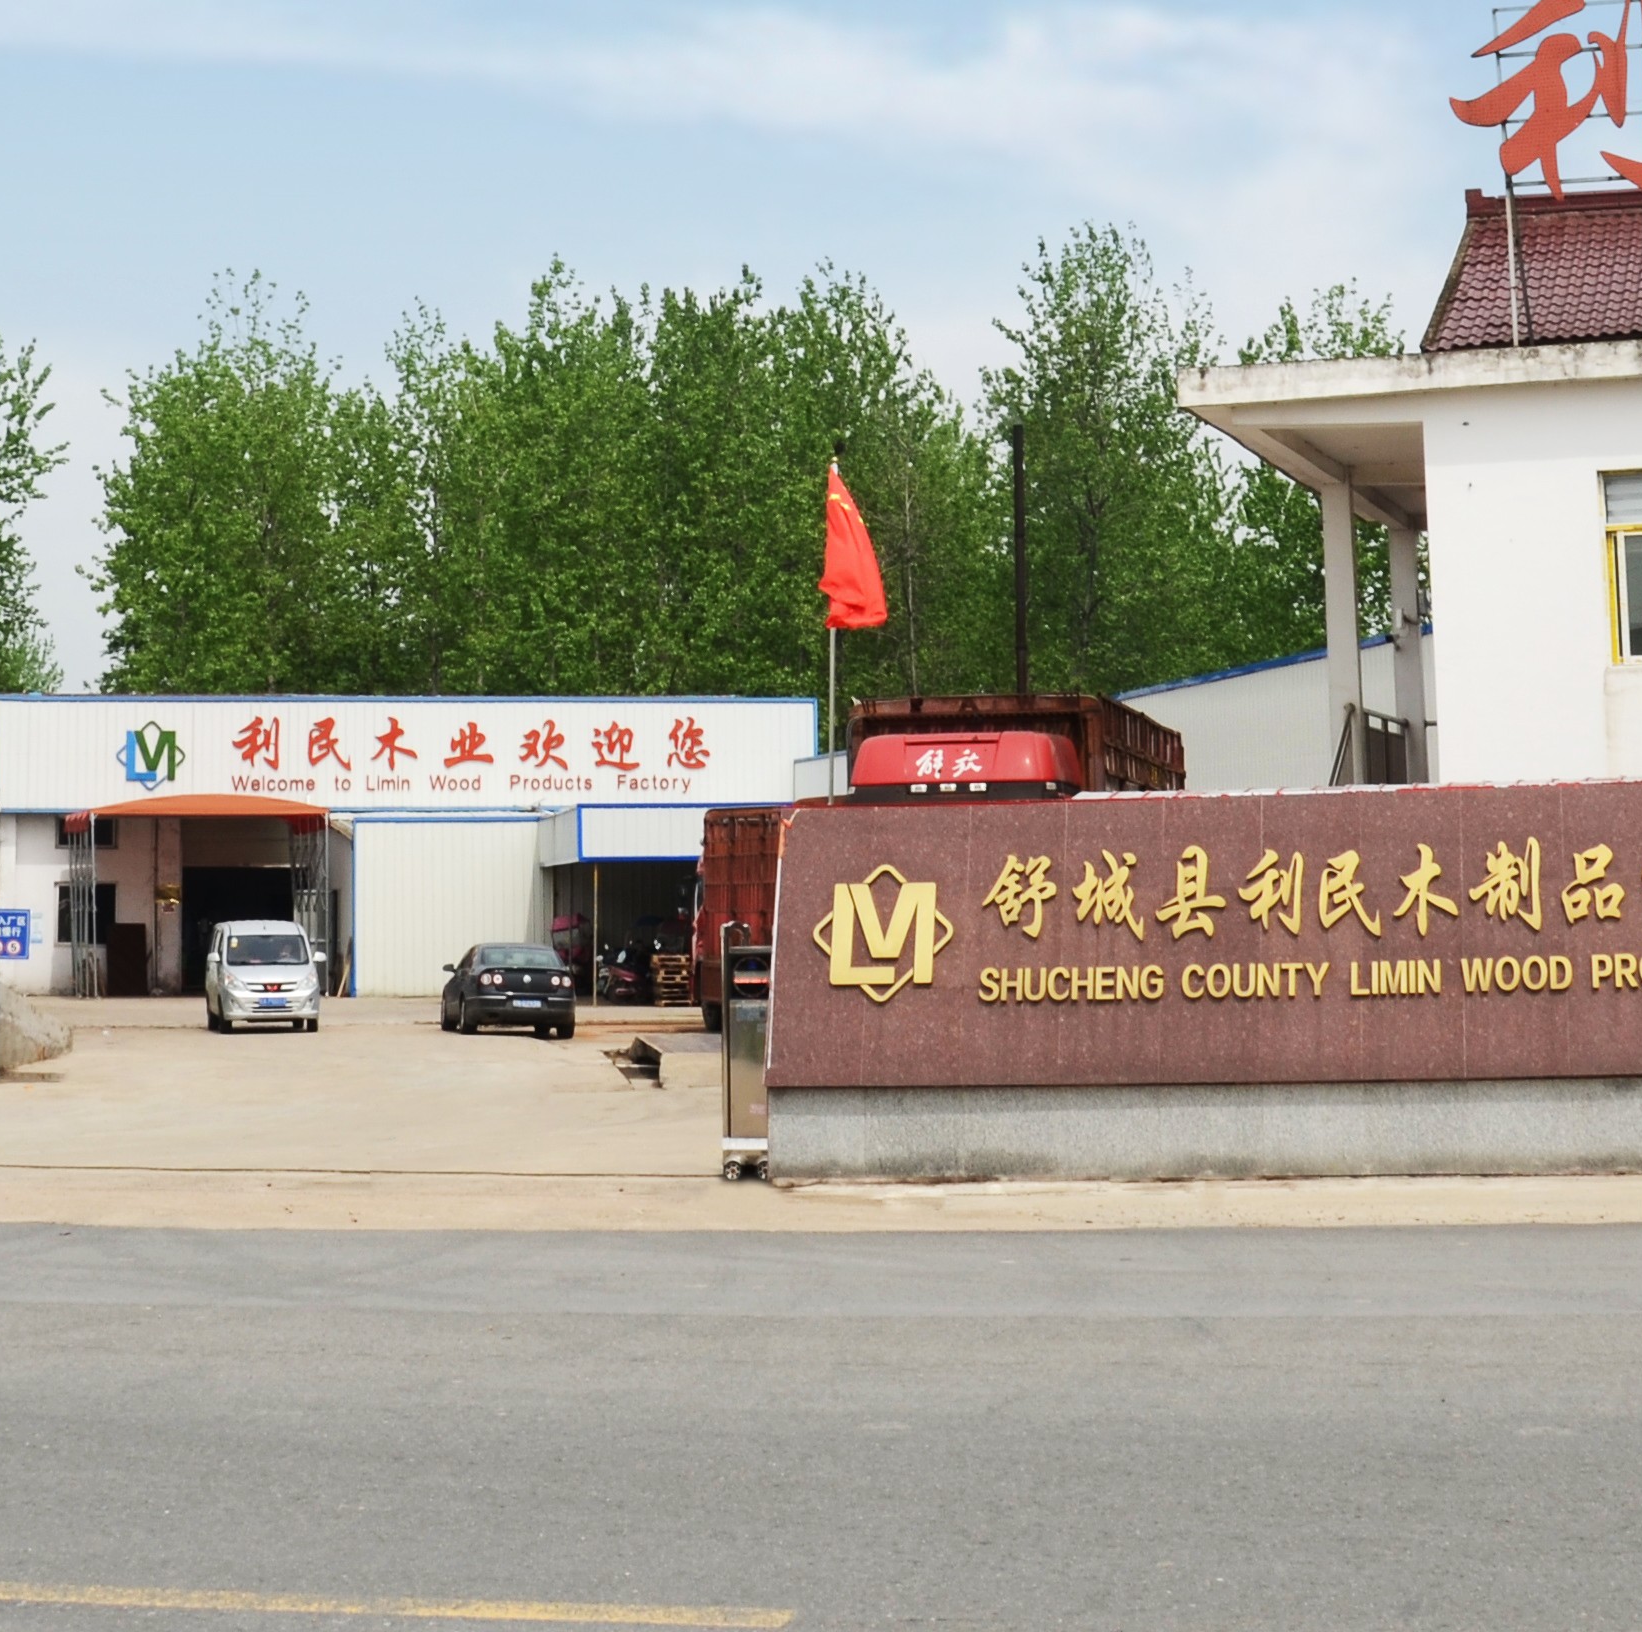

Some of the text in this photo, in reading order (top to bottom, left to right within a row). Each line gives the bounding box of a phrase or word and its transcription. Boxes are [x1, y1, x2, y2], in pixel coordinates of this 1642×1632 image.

[232, 715, 711, 771] 利民木业欢迎您
[232, 775, 692, 794] Welcome to Limin Wood Products Factory
[978, 964, 1164, 1003] SHUCHENG
[1181, 961, 1330, 1000] COUNTY
[1350, 959, 1442, 996] LIMIN
[1461, 955, 1574, 993] WOOD
